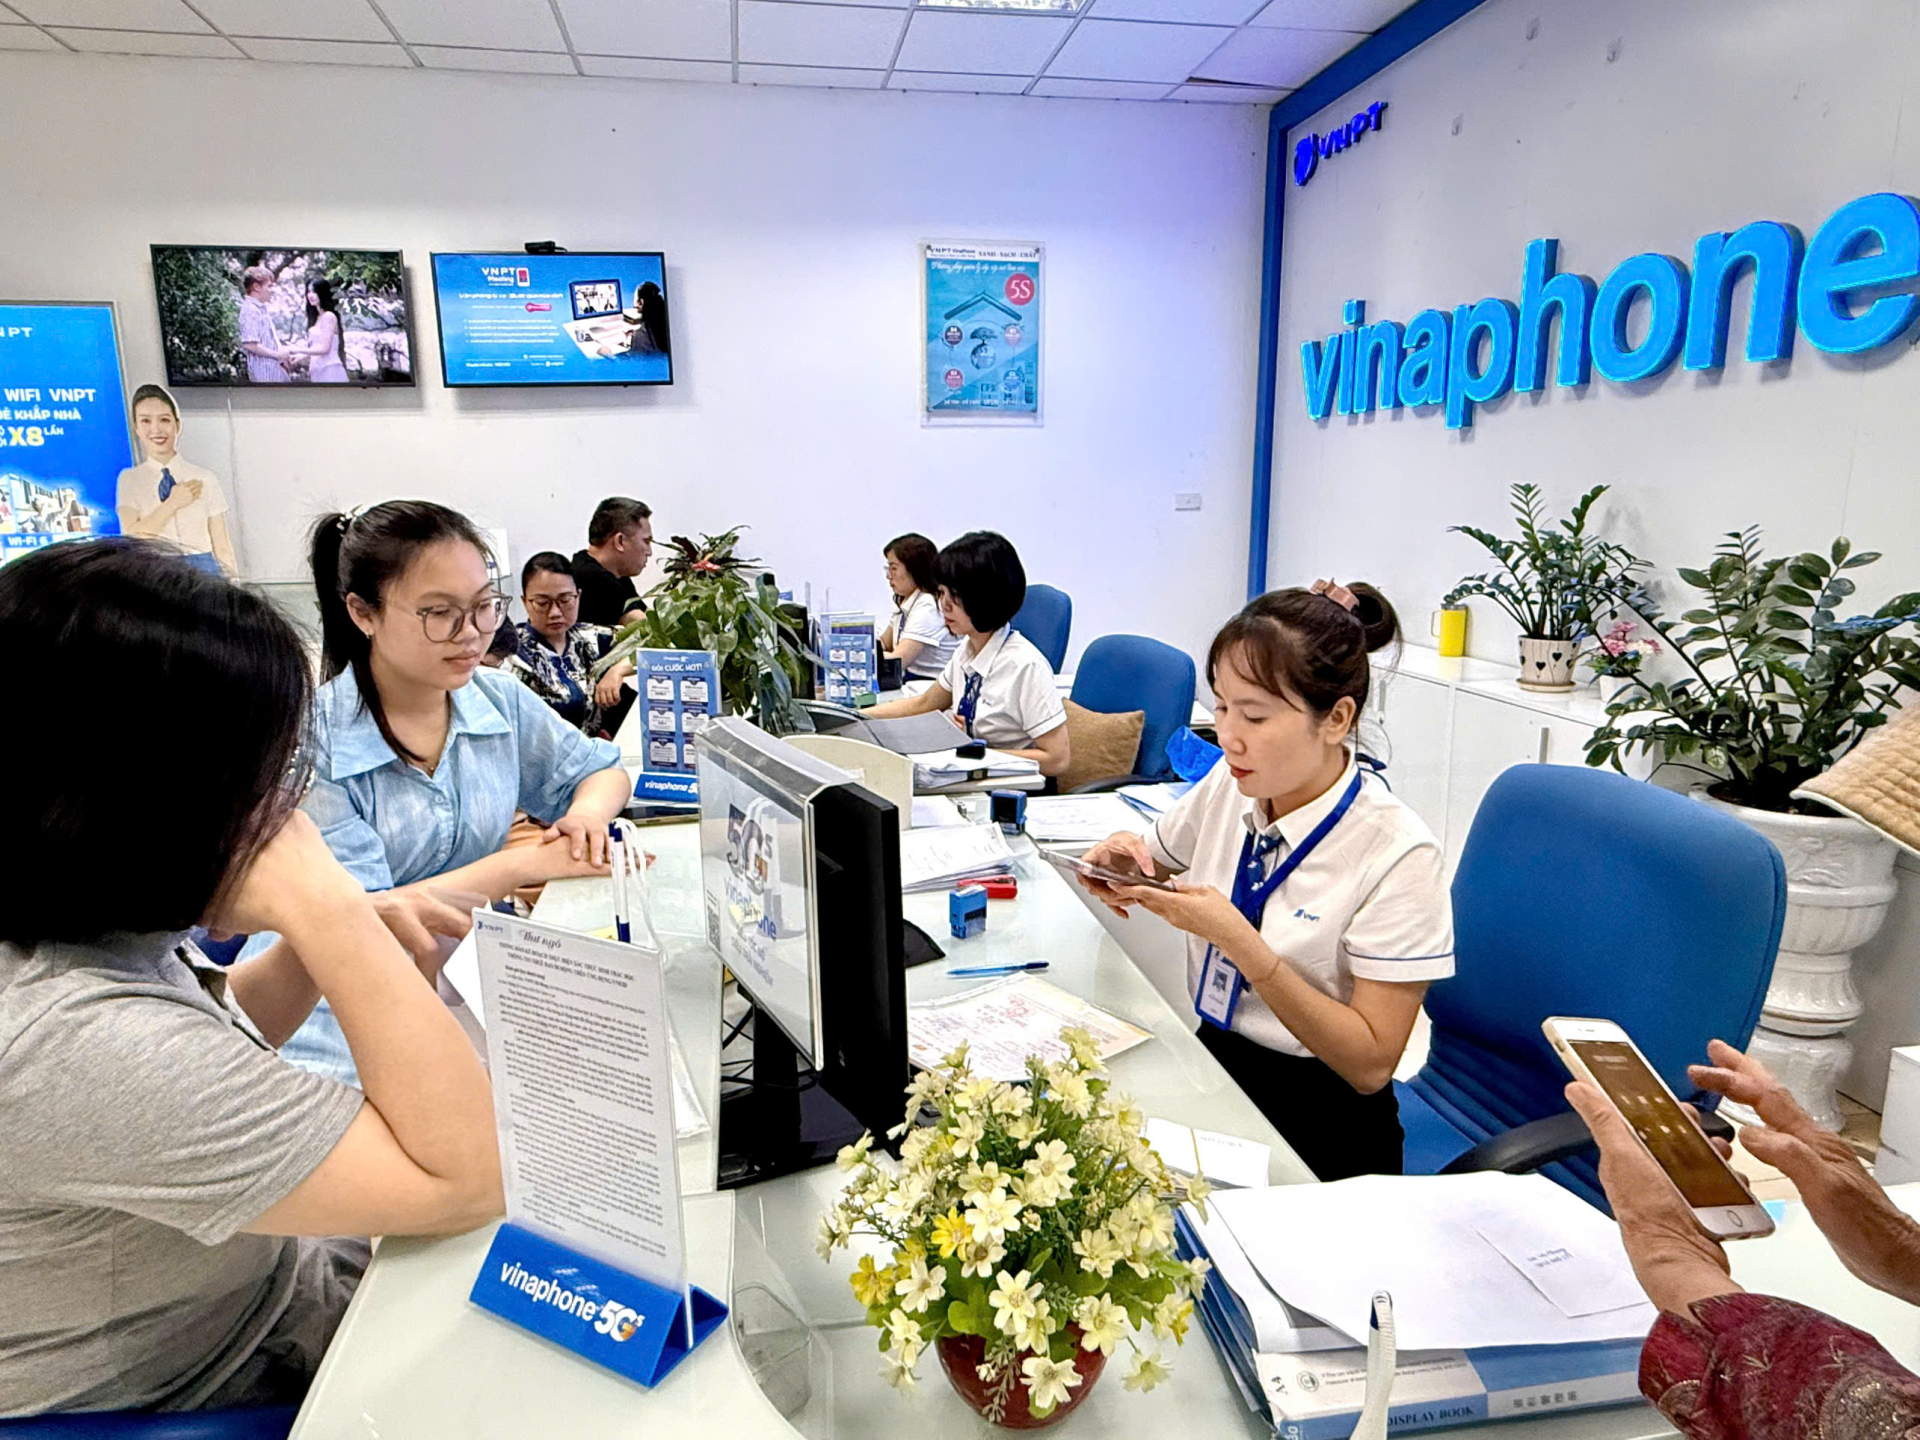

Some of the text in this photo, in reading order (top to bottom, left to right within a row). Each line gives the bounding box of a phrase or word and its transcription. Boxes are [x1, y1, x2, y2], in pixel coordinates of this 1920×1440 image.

[1318, 101, 1388, 159] VNPT
[481, 267, 515, 276] VNPT
[1010, 279, 1030, 299] 5S
[1300, 192, 1920, 430] vinaphone
[4, 388, 96, 402] WIFI VNPT
[53, 407, 82, 420] NHÀ
[7, 426, 45, 446] X8
[645, 780, 688, 791] vinaphone
[500, 1262, 596, 1321] vinaphone
[1271, 1375, 1288, 1395] A4
[1388, 1406, 1475, 1426] DISPLAY BOOK
